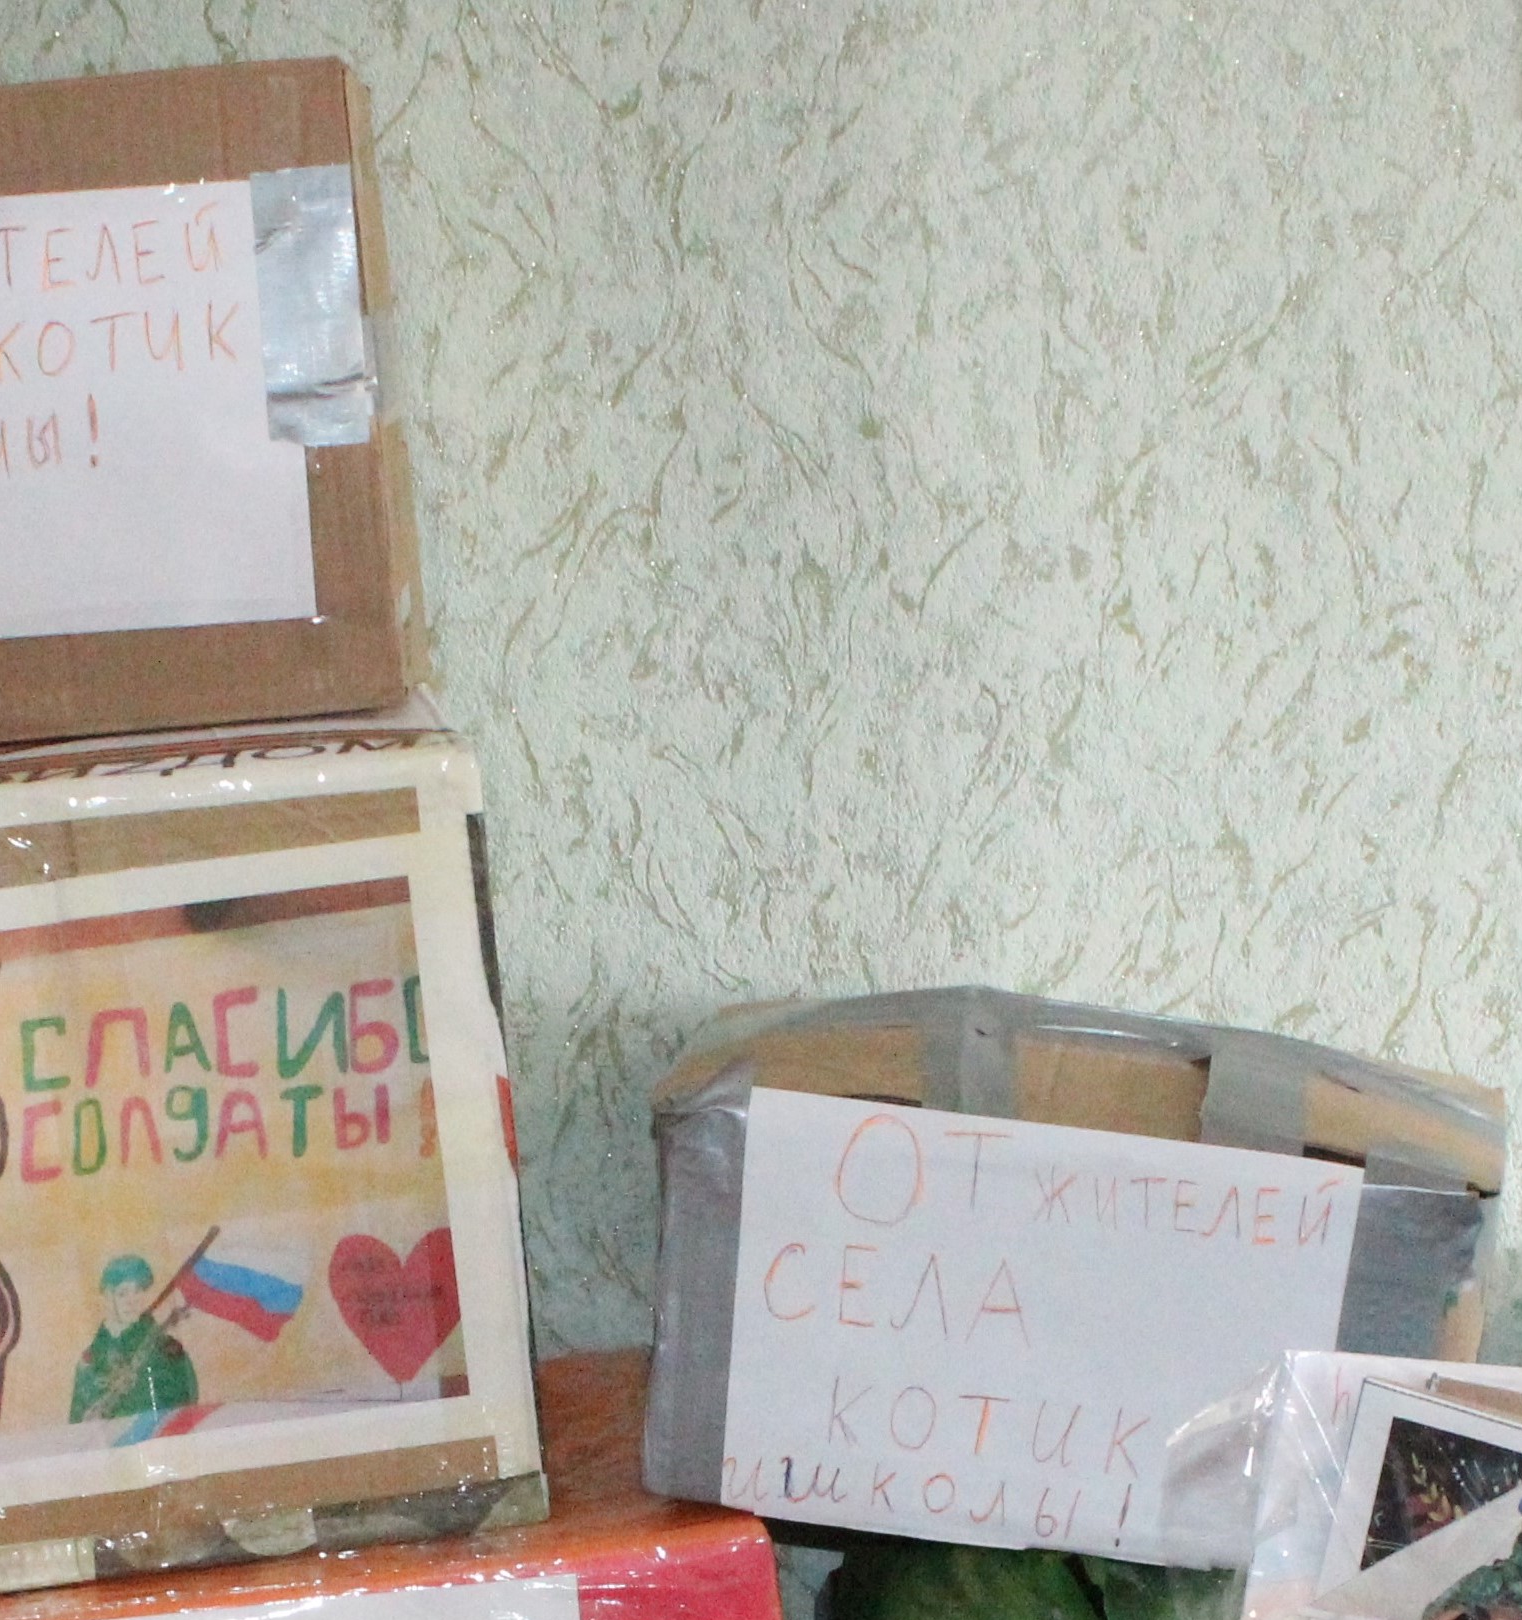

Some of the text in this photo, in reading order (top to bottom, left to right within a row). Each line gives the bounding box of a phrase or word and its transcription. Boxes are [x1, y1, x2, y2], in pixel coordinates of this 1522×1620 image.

[834, 1114, 1344, 1246] ОТ ЖИТЕЛЕЙ
[764, 1242, 1031, 1348] СЕЛА
[826, 1376, 1150, 1474] КОТИК
